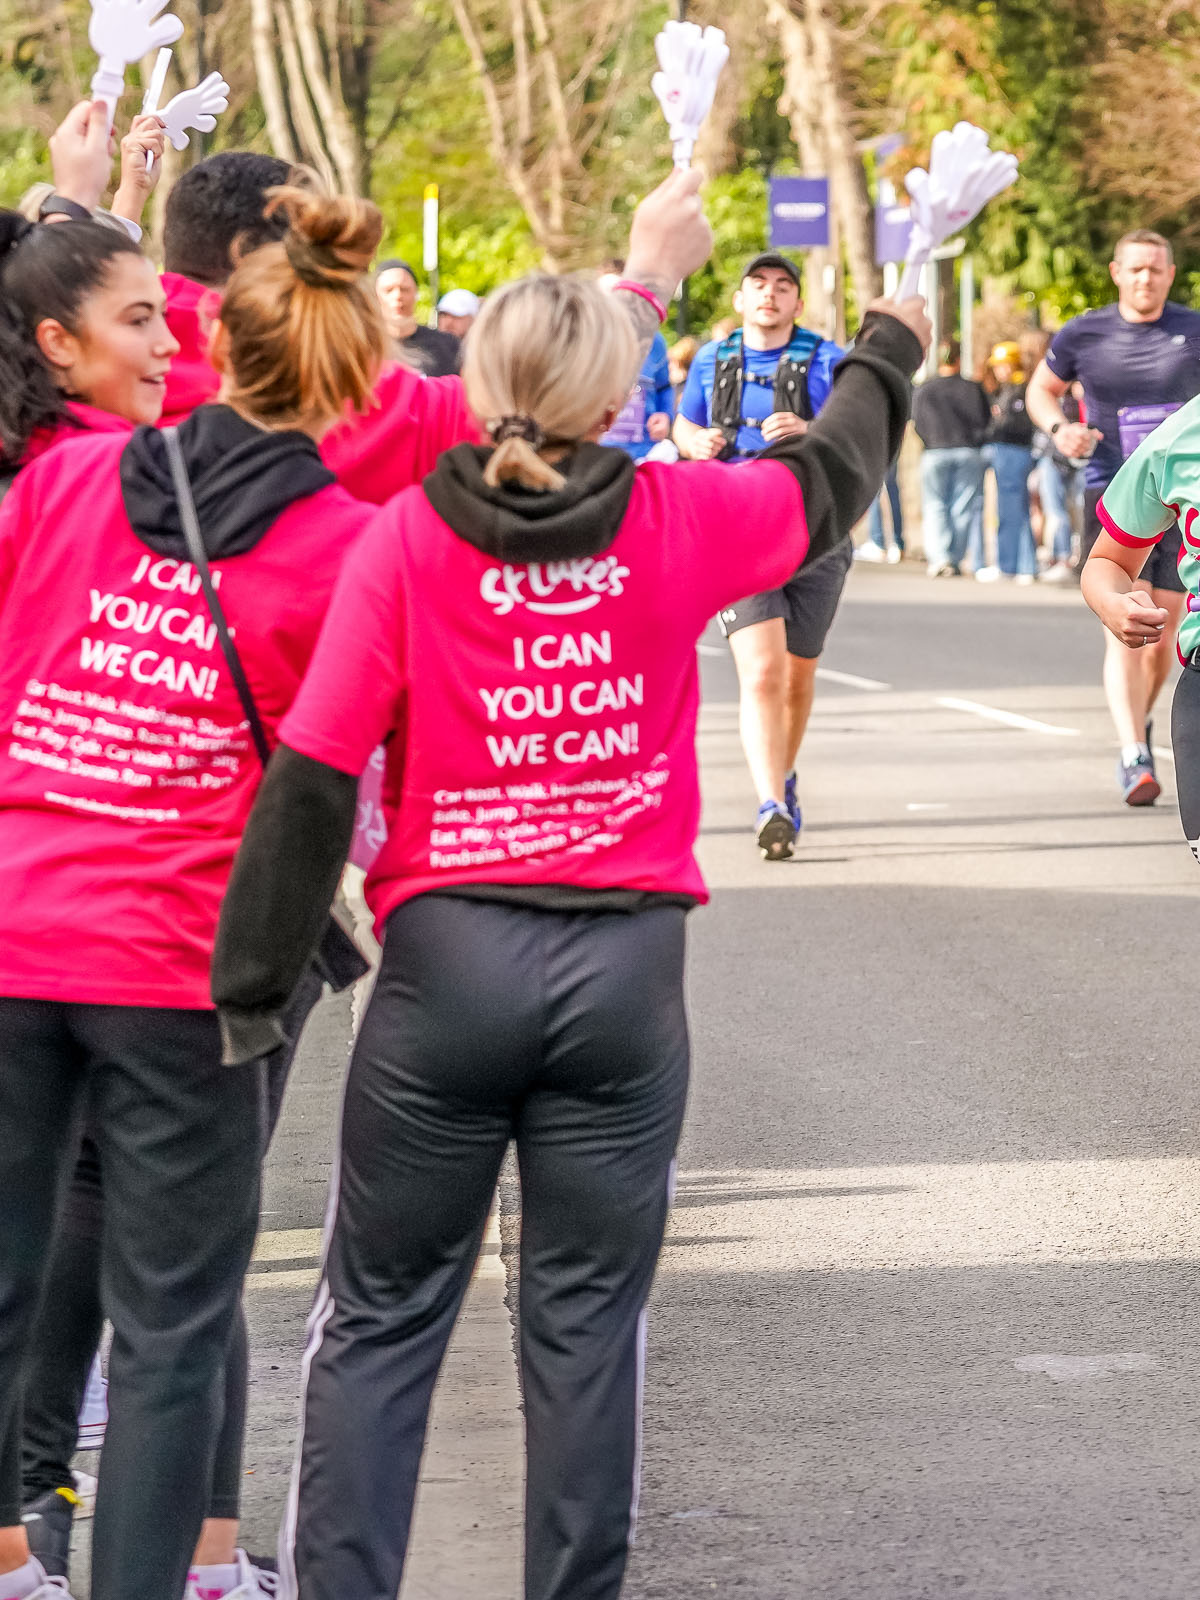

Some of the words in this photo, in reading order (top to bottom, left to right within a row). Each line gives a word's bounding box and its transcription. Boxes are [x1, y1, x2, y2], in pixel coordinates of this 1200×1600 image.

[131, 554, 151, 583] I
[528, 555, 631, 597] Luke's
[90, 589, 163, 634] YOU
[80, 637, 132, 678] WE
[130, 650, 219, 701] CAN!
[513, 637, 525, 671] I
[530, 630, 612, 669] CAN
[479, 684, 563, 721] YOU
[570, 674, 644, 715] CAN
[486, 733, 547, 767] WE
[554, 722, 639, 764] CAN!
